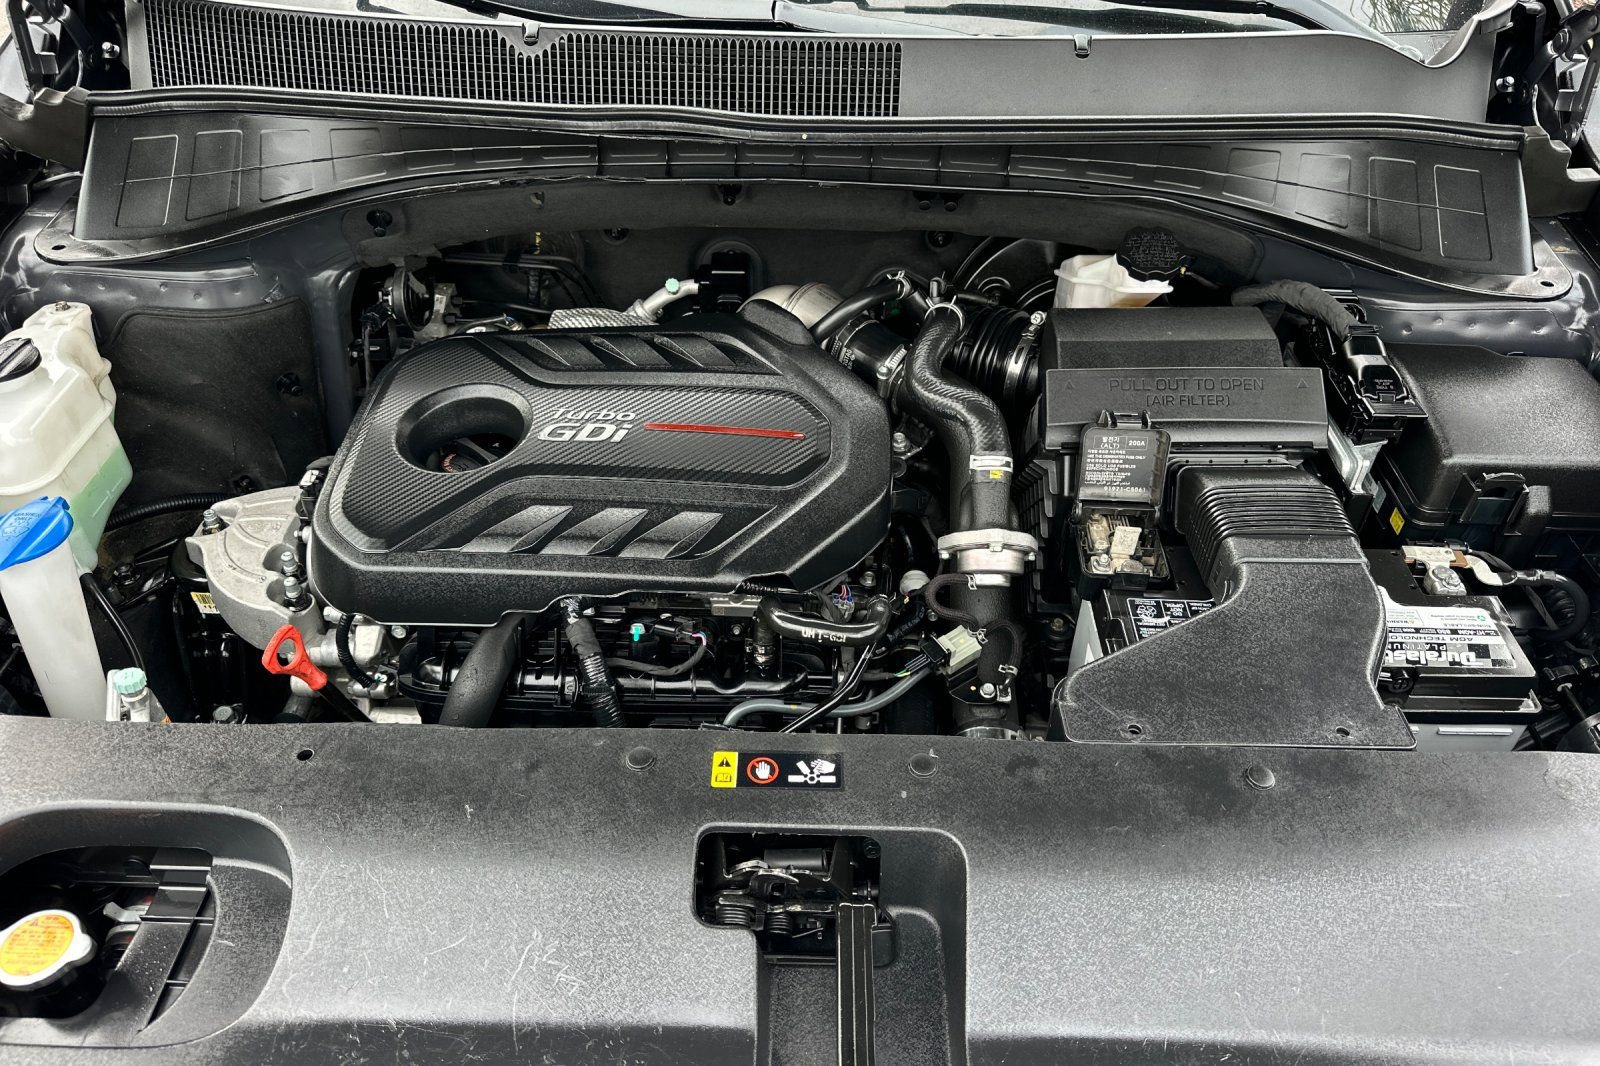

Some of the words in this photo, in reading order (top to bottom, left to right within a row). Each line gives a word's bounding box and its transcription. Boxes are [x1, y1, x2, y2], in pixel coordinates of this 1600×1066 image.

[1109, 378, 1150, 392] PULL
[1155, 378, 1188, 391] OUT
[1193, 378, 1216, 391] TO
[1221, 378, 1265, 391] OPEN
[552, 409, 636, 421] Turbo
[538, 423, 633, 442] GDi
[1385, 650, 1484, 667] Duralast
